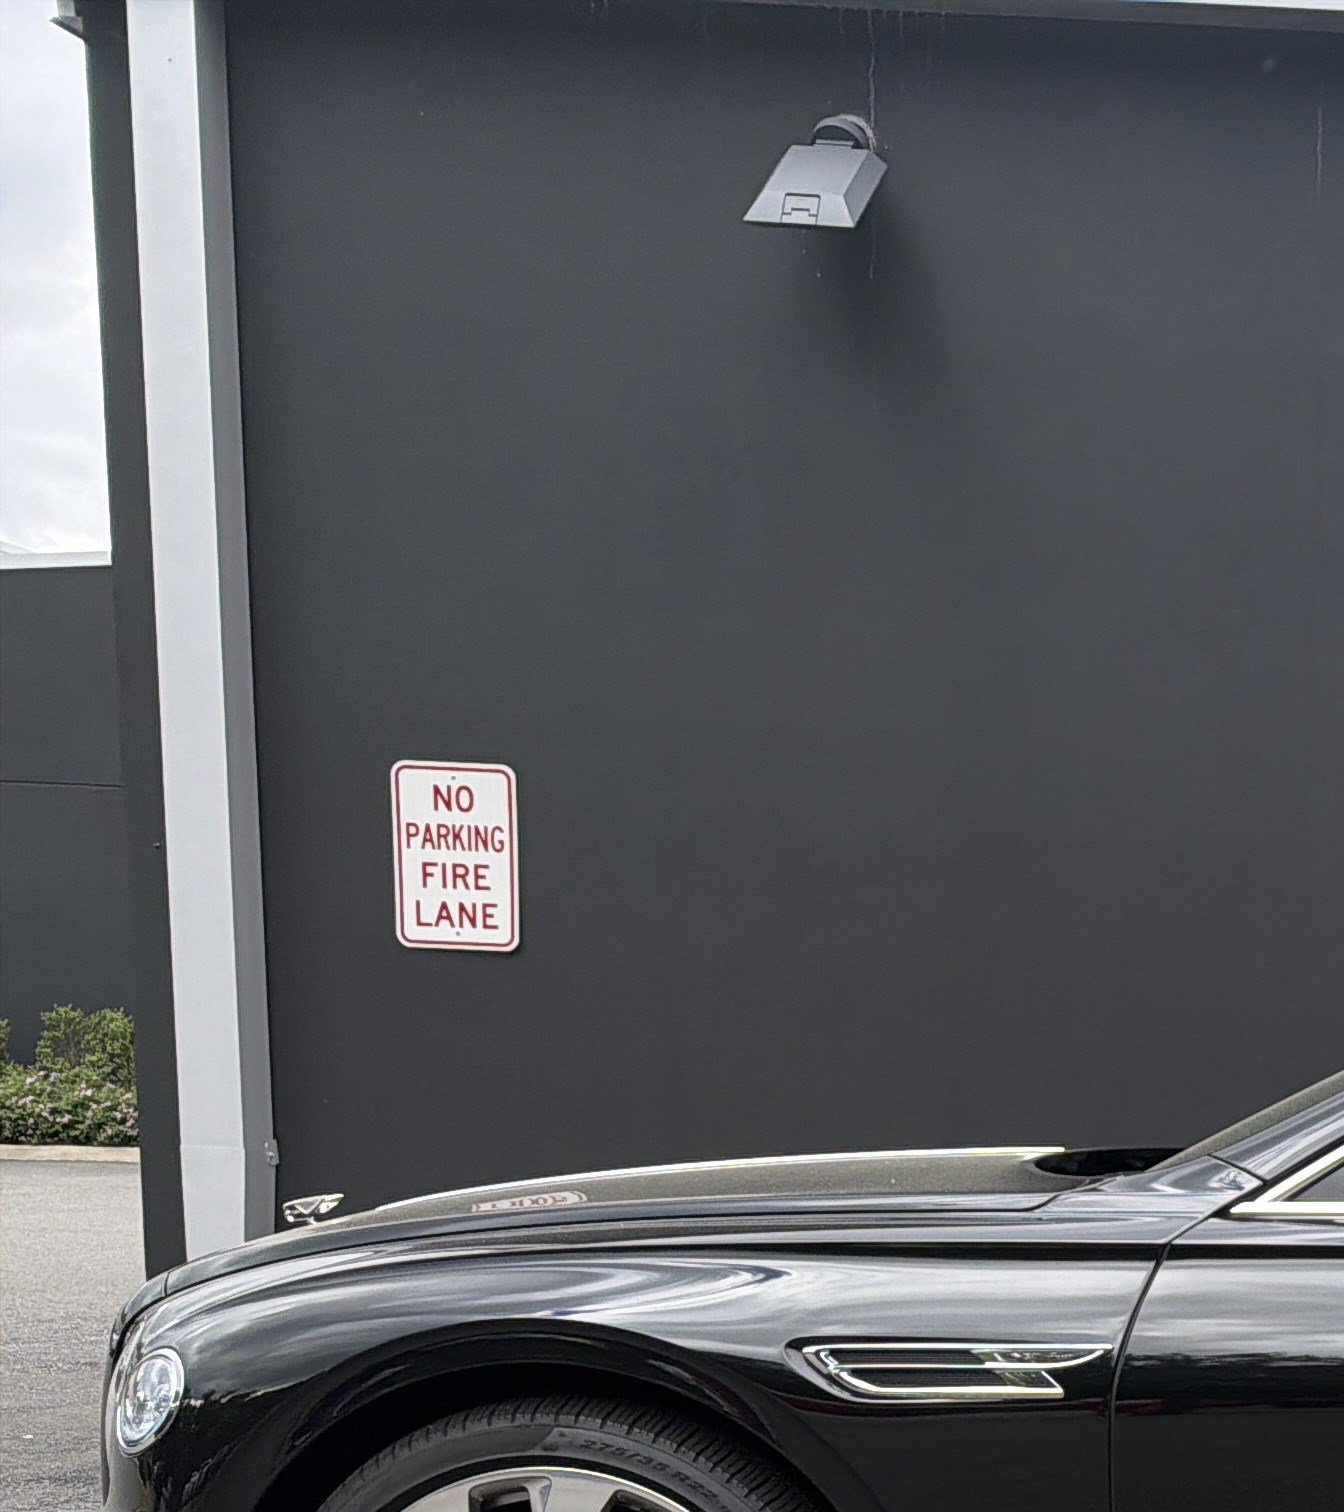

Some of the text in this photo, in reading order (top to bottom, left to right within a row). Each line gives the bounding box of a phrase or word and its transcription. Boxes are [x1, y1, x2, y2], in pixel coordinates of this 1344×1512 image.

[433, 784, 475, 813] NO
[405, 822, 505, 853] PARKING
[421, 862, 491, 891] FIRE
[415, 900, 499, 930] LANE
